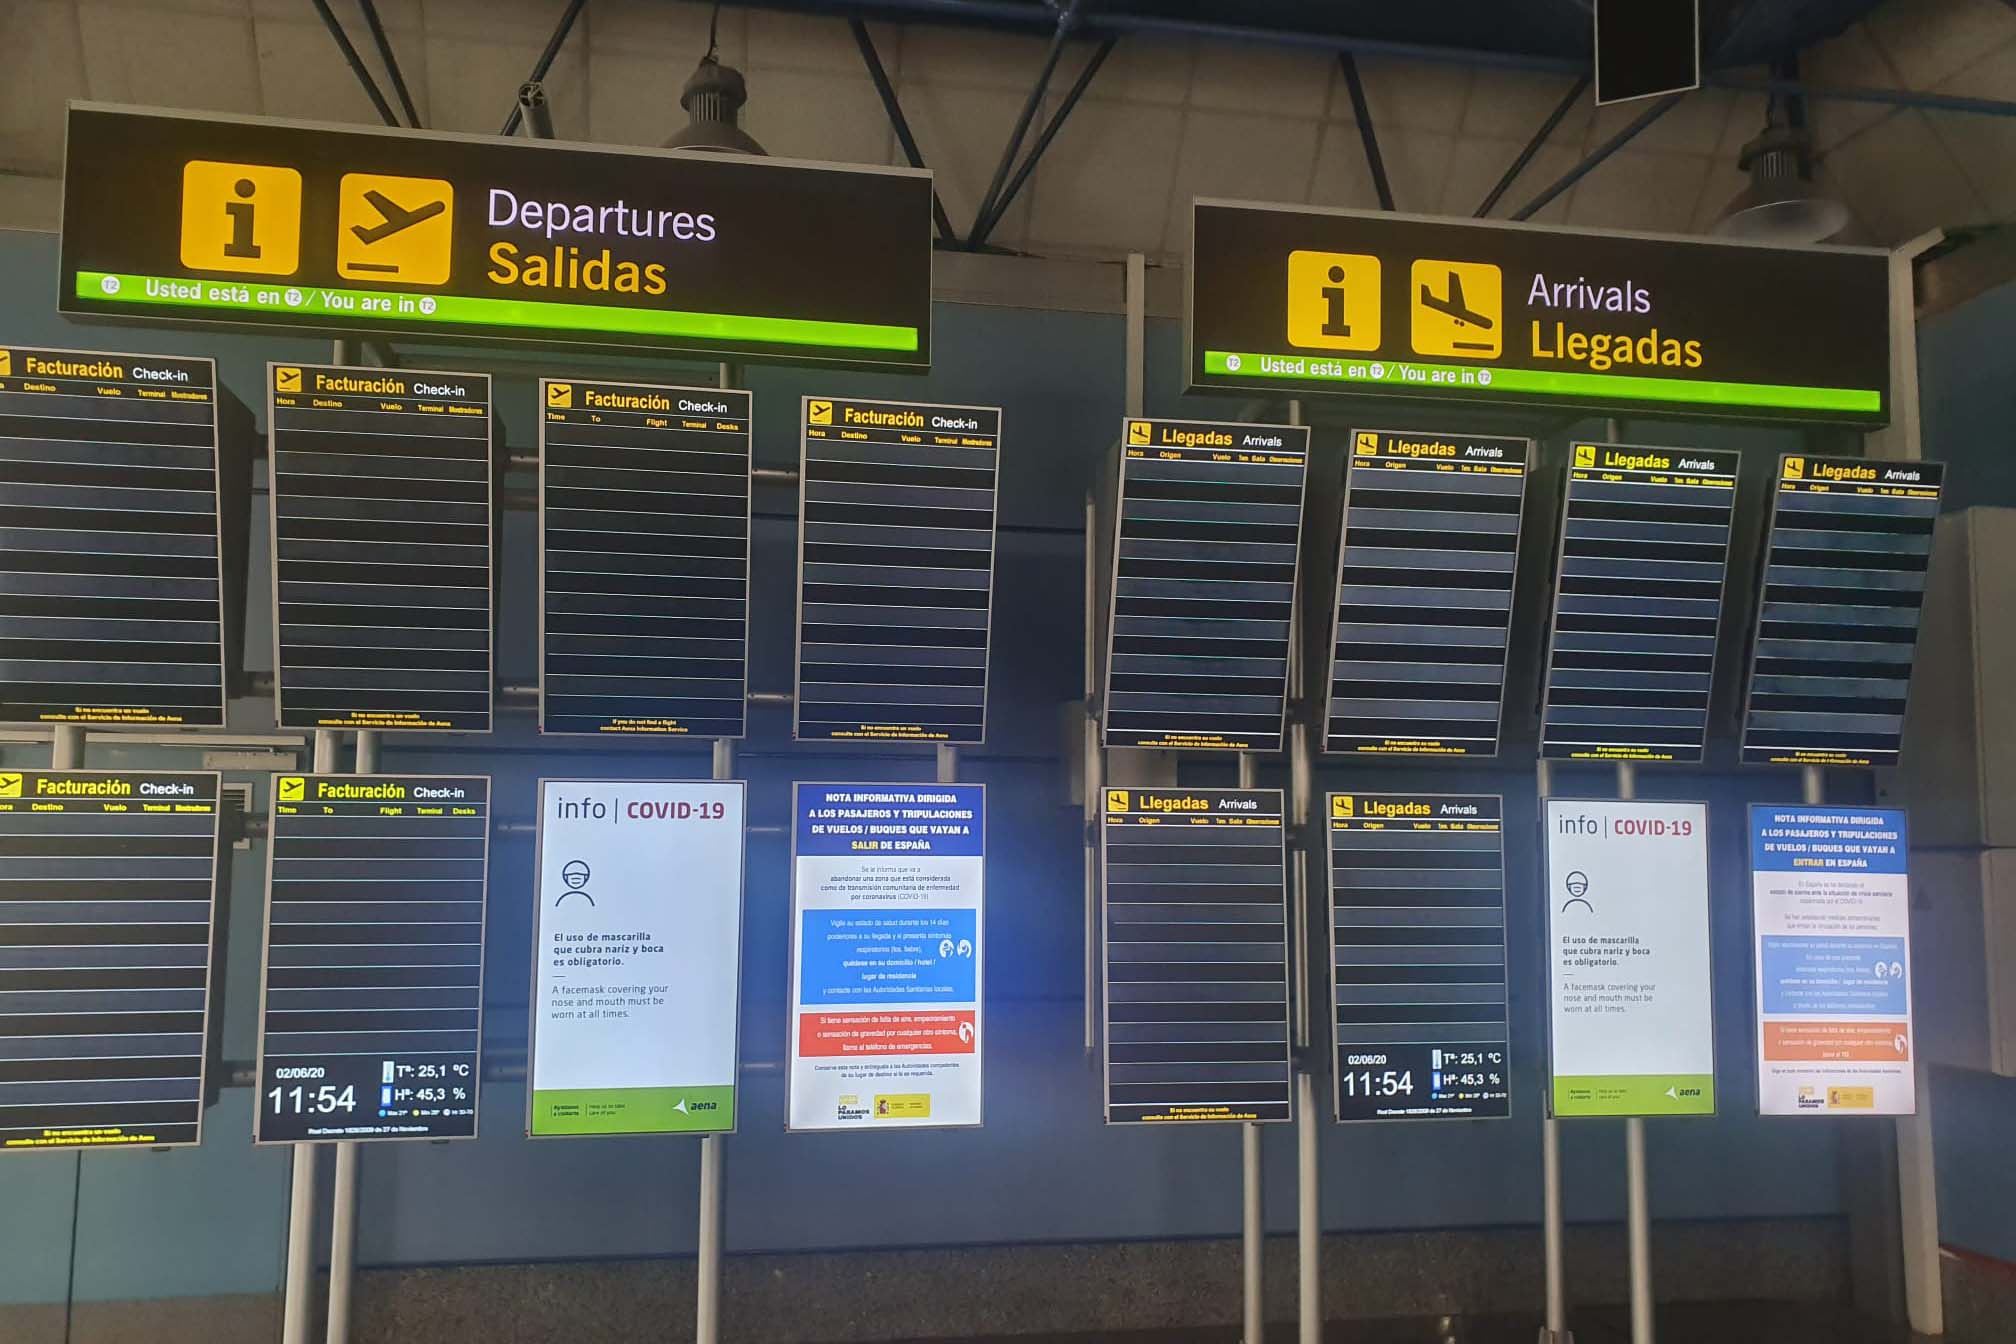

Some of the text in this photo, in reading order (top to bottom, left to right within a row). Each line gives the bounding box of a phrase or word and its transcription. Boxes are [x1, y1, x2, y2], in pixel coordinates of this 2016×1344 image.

[488, 188, 717, 243] Departures
[488, 243, 667, 295] Salidas
[146, 280, 201, 299] Usted
[209, 286, 249, 302] está
[258, 290, 279, 304] en
[322, 292, 353, 308] You
[362, 297, 391, 312] are
[399, 295, 414, 312] in
[1528, 273, 1651, 313] Arrivals
[1532, 320, 1703, 370] Llegadas
[26, 357, 188, 381] Facturación Check-in
[1261, 357, 1304, 374] Usted
[1310, 360, 1342, 377] está
[1349, 365, 1366, 378] en
[1399, 366, 1426, 382] You
[1432, 369, 1455, 383] are
[1462, 369, 1474, 384] in
[316, 375, 465, 396] Facturación Check-in
[313, 399, 342, 407] Destino
[381, 403, 402, 411] Vuelo
[586, 391, 727, 413] Facturación Check-in
[647, 418, 668, 427] Flight
[845, 408, 978, 429] Facturación Check-in
[1162, 429, 1282, 447] Llegadas Arrivals
[1388, 439, 1503, 458] Llegadas Arrivals
[1605, 452, 1714, 470] Llegadas Arrivals
[1813, 464, 1920, 481] Llegadas Arrivals
[37, 779, 193, 795] Facturación Check-in
[318, 783, 464, 799] Facturación Check-in
[826, 793, 956, 803] NOTA INFORMATIVA DIRIGIDA
[1140, 796, 1257, 812] Llegadas Arrivals
[558, 797, 725, 819] info COVID-19
[818, 810, 836, 818] LOS
[838, 810, 891, 818] PASAJEROS
[893, 810, 899, 818] Y
[902, 810, 973, 819] TRIPULACIONES
[1364, 801, 1477, 817] Llegadas Arrivals
[1559, 815, 1692, 836] info COVID-19
[1775, 815, 1883, 824] NOTA INFORMATIVA DIRIGIDA
[812, 825, 969, 834] DE VUELOS / BUQUES QUE VAYAN A
[1769, 829, 1783, 837] LOS
[1785, 830, 1829, 838] PASAJEROS
[1831, 830, 1835, 838] Y
[852, 840, 930, 850] SALIR DE ESPAÑA
[555, 933, 563, 941] El
[587, 933, 598, 941] de
[602, 933, 650, 941] mascarilla
[1600, 936, 1639, 944] mascarilla
[554, 946, 572, 954] que
[575, 945, 602, 954] cubra
[605, 945, 629, 953] nariz
[642, 945, 664, 953] boca
[1604, 947, 1623, 955] nariz
[1632, 947, 1650, 955] boca
[568, 957, 625, 967] obligatorio.
[552, 985, 668, 994] A facemask covering your
[552, 997, 664, 1007] nose and mouth must be
[552, 1011, 574, 1019] worn
[589, 1010, 599, 1018] all
[603, 1010, 629, 1018] times.
[1348, 1055, 1386, 1065] 02/06/20
[1461, 1053, 1483, 1065] 25,1
[276, 1067, 325, 1079] 02/06/20
[418, 1064, 446, 1078] 25,1
[1344, 1070, 1413, 1096] 11:54
[1461, 1074, 1484, 1085] 45,3
[1489, 1074, 1500, 1084] %
[417, 1088, 445, 1101] 45,3
[453, 1088, 465, 1100] %
[1680, 1088, 1700, 1096] aena
[268, 1085, 356, 1114] 11:54
[690, 1102, 717, 1111] aena
